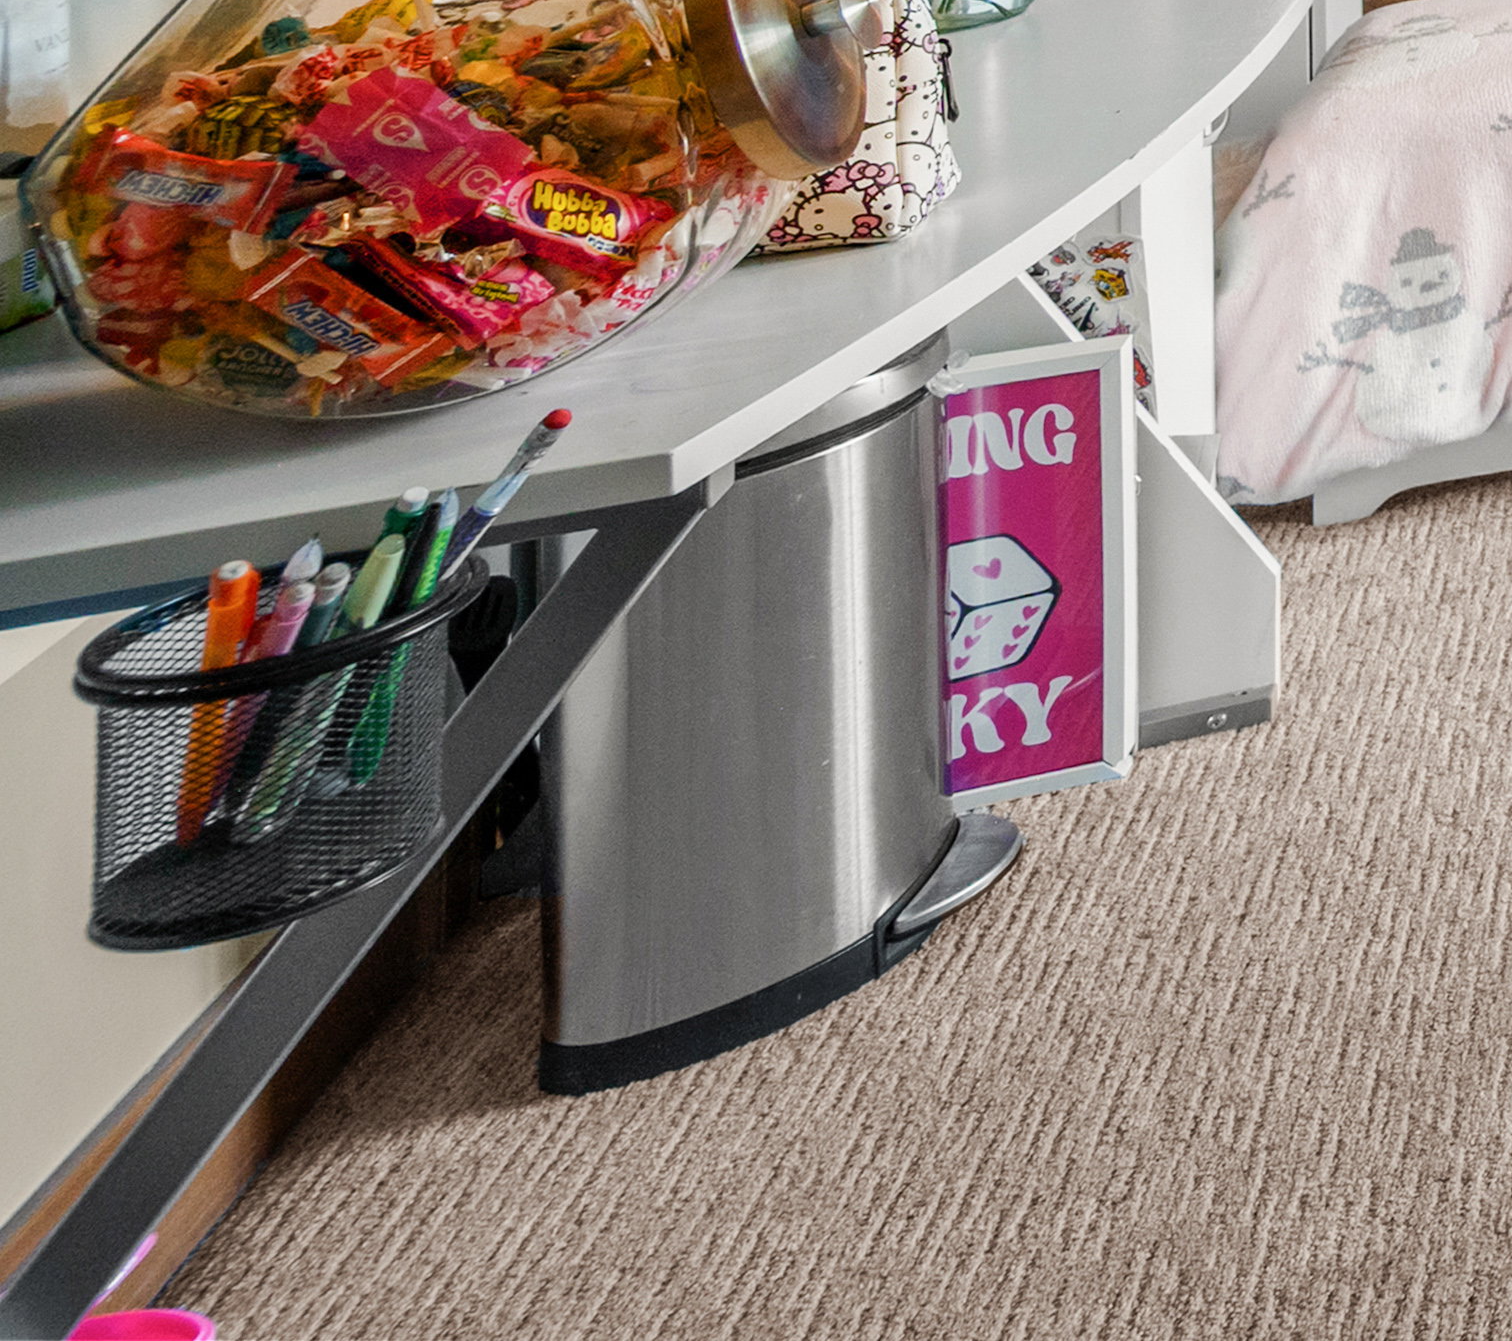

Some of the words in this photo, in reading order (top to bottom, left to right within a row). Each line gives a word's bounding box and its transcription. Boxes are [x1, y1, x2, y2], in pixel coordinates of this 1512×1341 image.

[116, 170, 226, 207] HI-CHEW
[532, 180, 609, 213] Hubba
[283, 298, 381, 355] HI-CHEW
